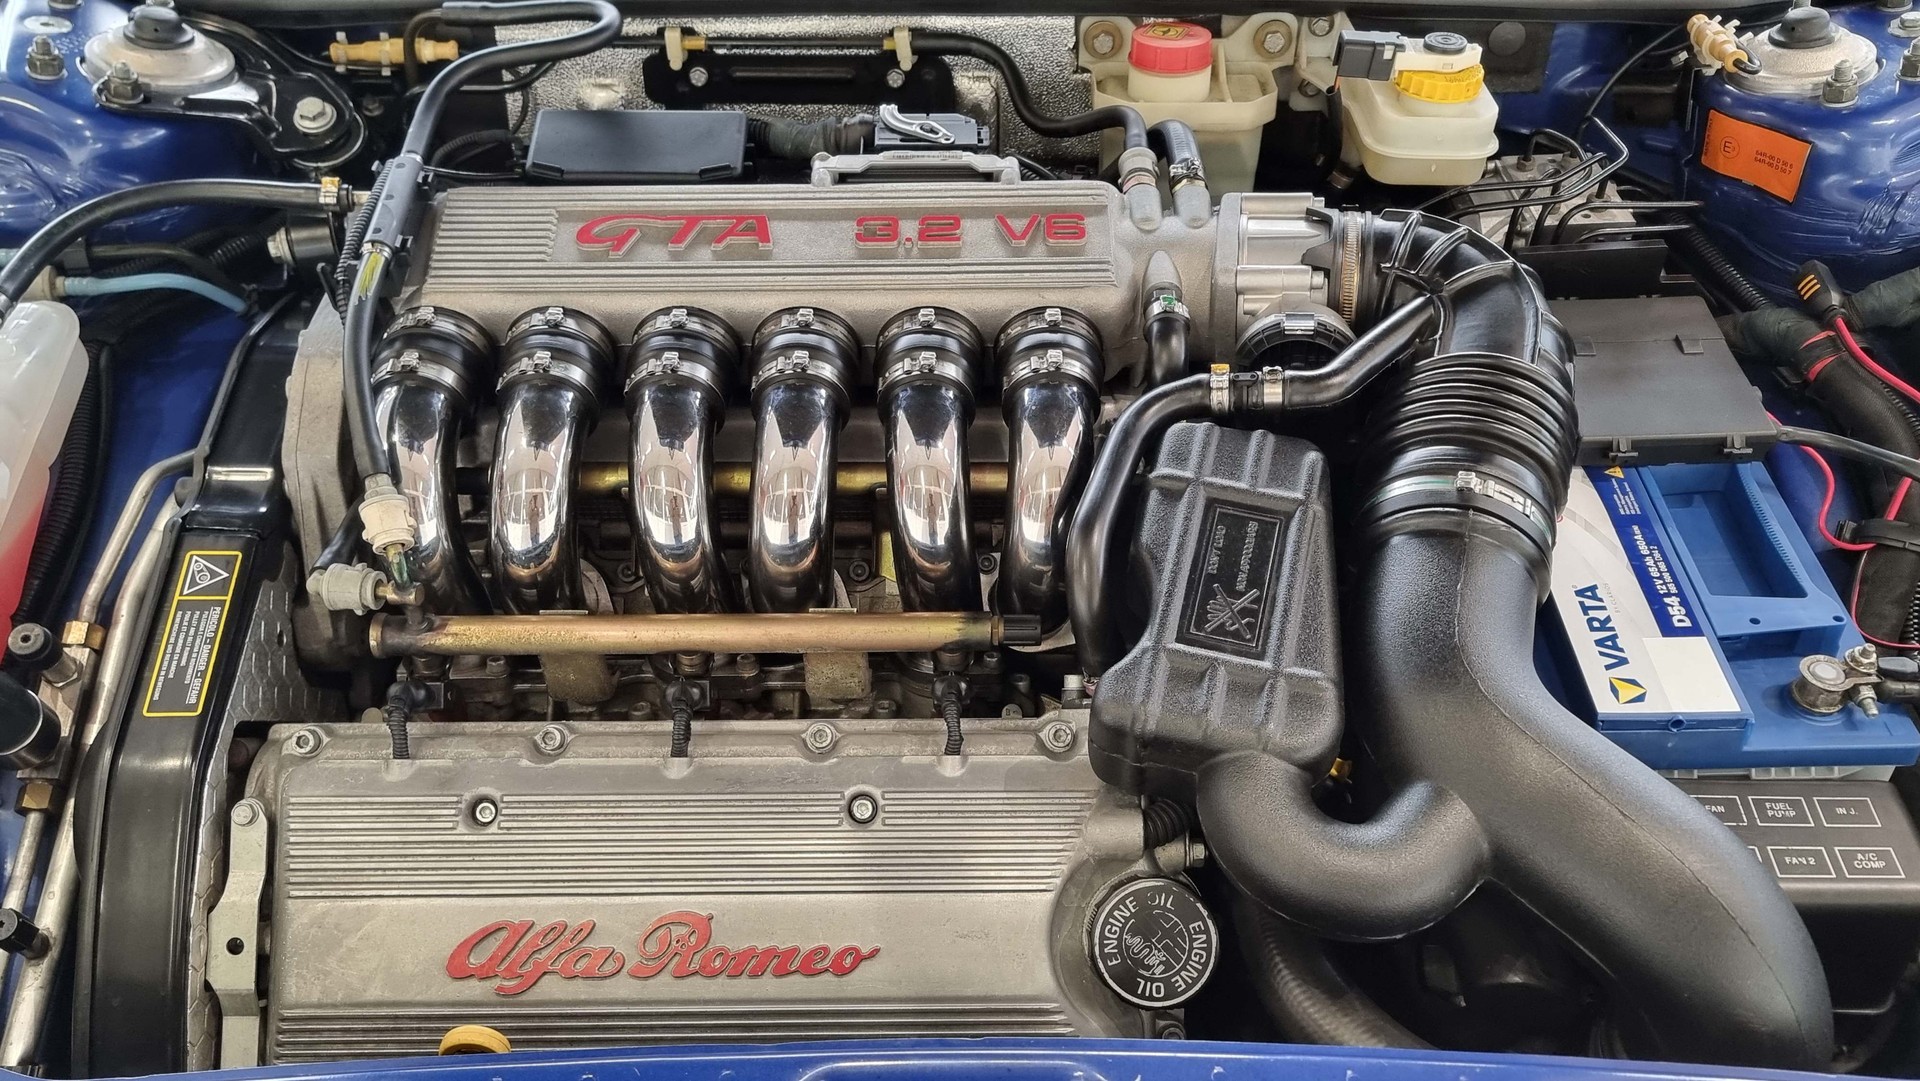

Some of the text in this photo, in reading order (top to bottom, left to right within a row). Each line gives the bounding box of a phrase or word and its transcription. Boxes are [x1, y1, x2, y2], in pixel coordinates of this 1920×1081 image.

[576, 214, 772, 257] GTA
[854, 214, 1087, 248] 3.2 V6
[1644, 556, 1660, 578] 65Ah
[1654, 578, 1668, 595] 12V
[207, 606, 221, 637] PERICOLO
[1663, 596, 1692, 628] D54
[1574, 584, 1630, 672] VARTA
[198, 644, 211, 671] DANGER
[189, 678, 202, 704] GEFAHR
[1784, 857, 1806, 865] FAN
[1854, 860, 1886, 869] COMP
[1104, 892, 1174, 966] ENGINE OIL
[446, 911, 881, 996] Alfa Romeo
[1137, 920, 1207, 997] ENGINE OIL
